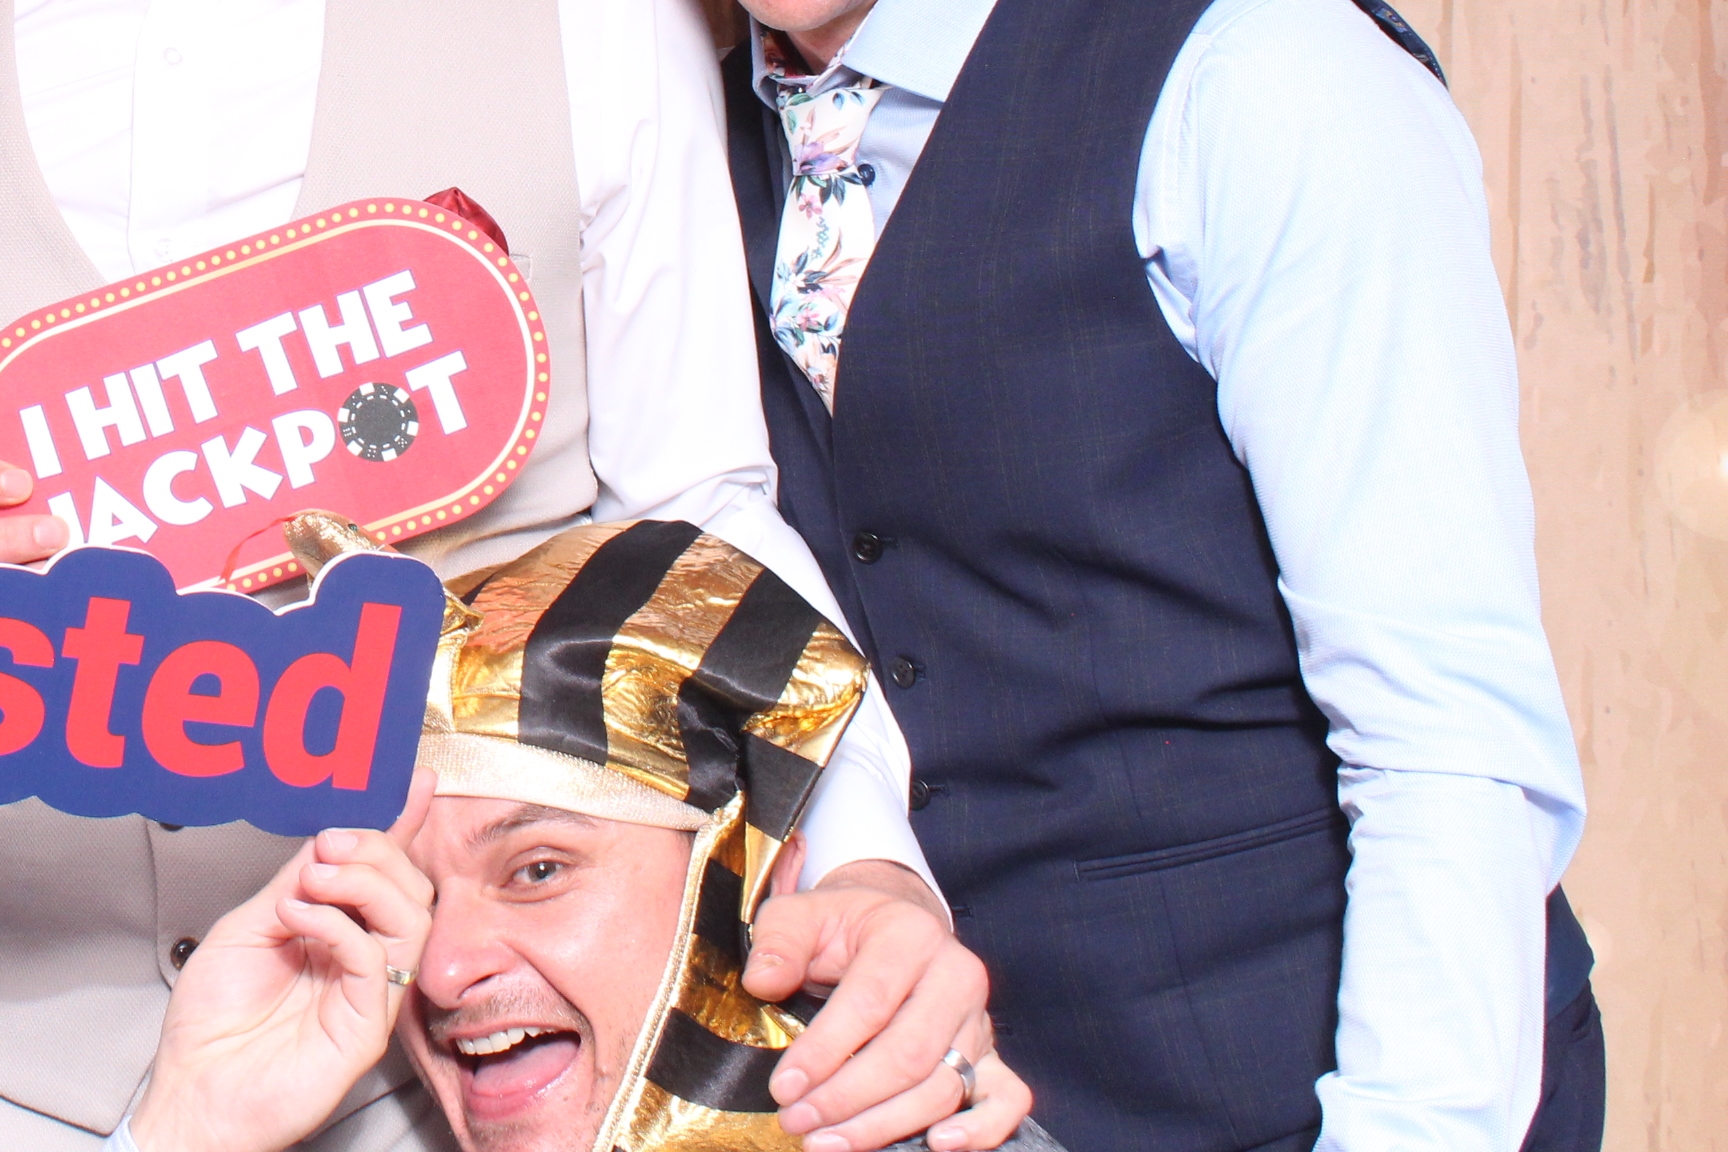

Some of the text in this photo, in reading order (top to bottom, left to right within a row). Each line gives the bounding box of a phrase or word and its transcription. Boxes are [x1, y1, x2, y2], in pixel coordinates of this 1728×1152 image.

[19, 269, 434, 480] I HIT THE
